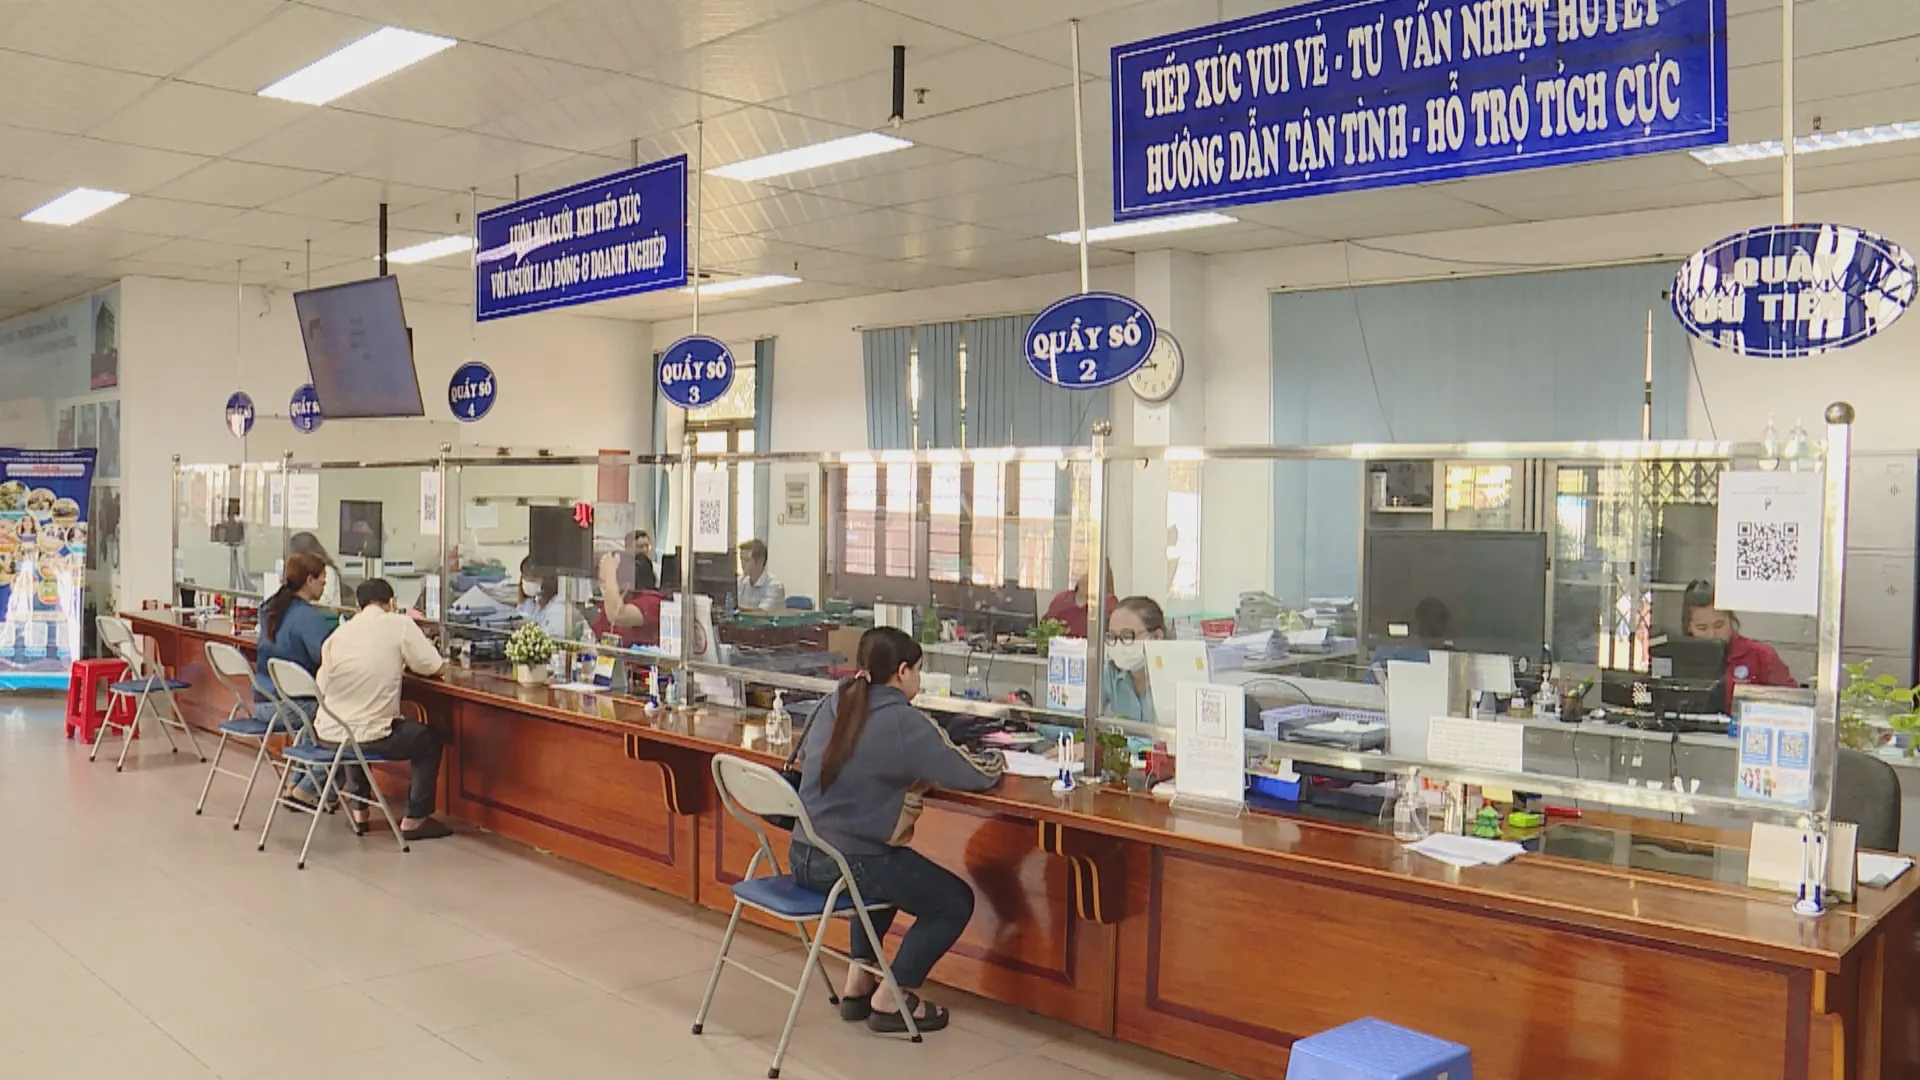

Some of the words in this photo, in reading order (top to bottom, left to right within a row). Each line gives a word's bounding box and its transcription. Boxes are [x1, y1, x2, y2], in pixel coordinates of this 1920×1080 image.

[1142, 51, 1190, 118] TIẾP
[1195, 44, 1242, 108] XÚC
[1246, 41, 1289, 98] VUI
[1294, 18, 1329, 89] VẺ
[1348, 13, 1384, 80] TƯ
[1393, 0, 1453, 71] VẤN
[1146, 126, 1225, 194] HƯỚNG
[1229, 107, 1280, 181] DẪN
[1285, 107, 1335, 181] TẬN
[1341, 96, 1408, 165] TÌNH
[1426, 71, 1465, 154] HỖ
[1471, 75, 1530, 155] TRỢ
[1536, 59, 1608, 138] TÍCH
[1615, 51, 1680, 137] CỰC
[576, 204, 594, 238] KHI
[595, 191, 617, 232] TIẾP
[619, 187, 641, 227] XÚC
[535, 260, 553, 292] LAO
[591, 244, 626, 280] DOANH
[1108, 311, 1142, 348] SỐ
[706, 352, 727, 379] SỐ
[1079, 359, 1097, 381] 2
[479, 373, 493, 397] SỐ
[689, 386, 700, 403] 3
[467, 402, 476, 418] 4
